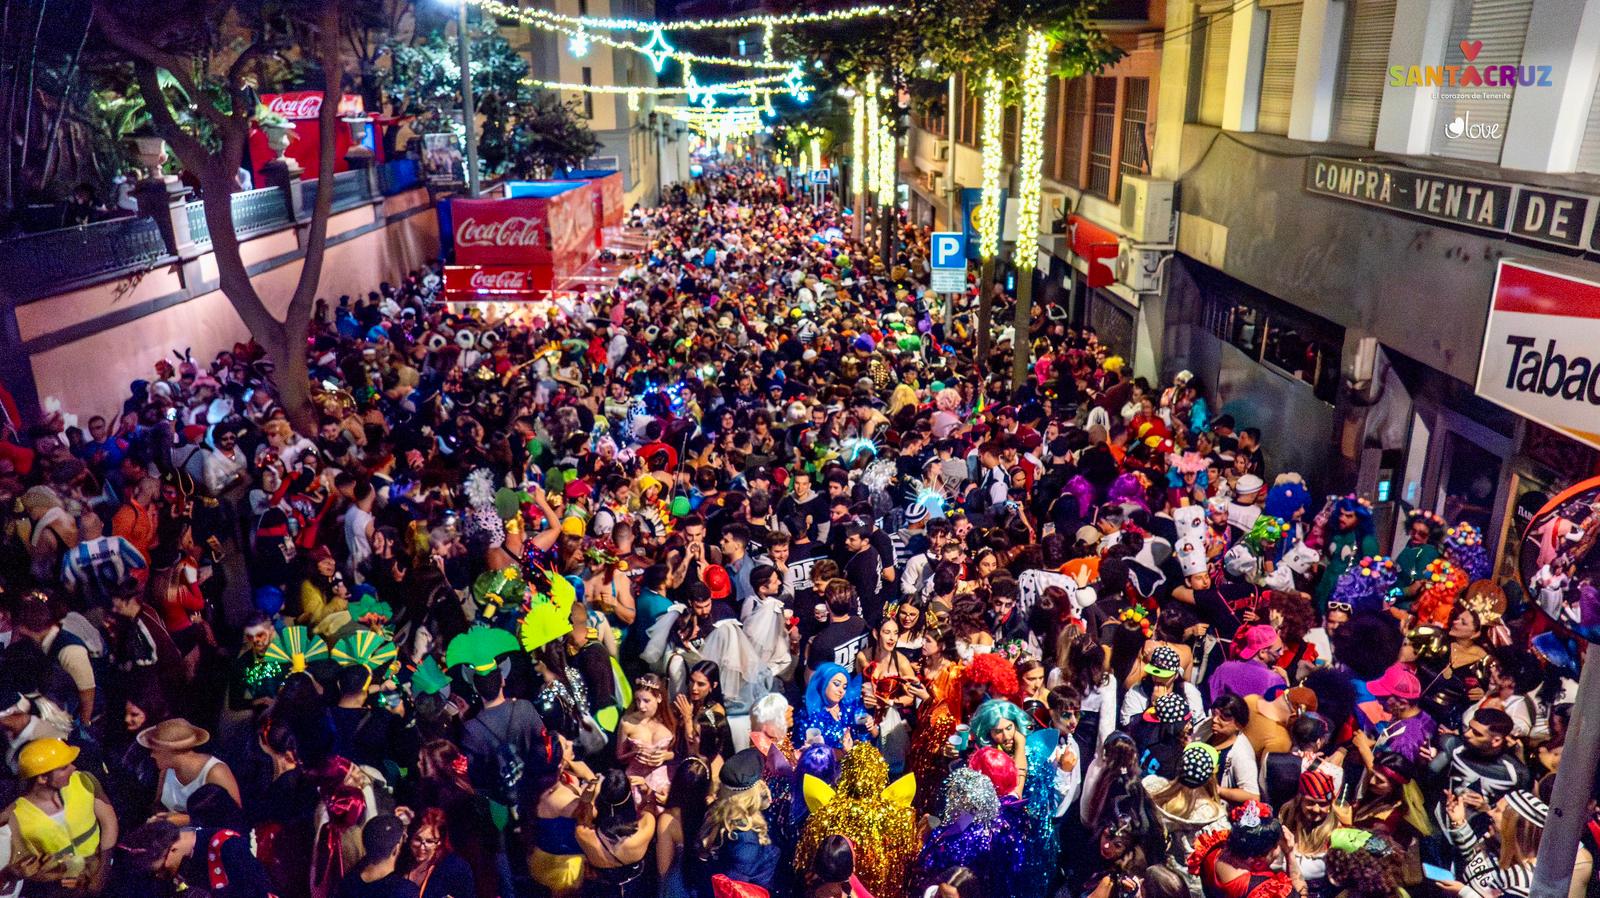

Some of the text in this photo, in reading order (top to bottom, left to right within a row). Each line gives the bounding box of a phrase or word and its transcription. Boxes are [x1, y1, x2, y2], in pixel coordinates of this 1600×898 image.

[1315, 163, 1391, 202] COMPRA
[1415, 178, 1494, 225] VENTA
[1524, 196, 1573, 238] DE
[939, 237, 960, 265] P
